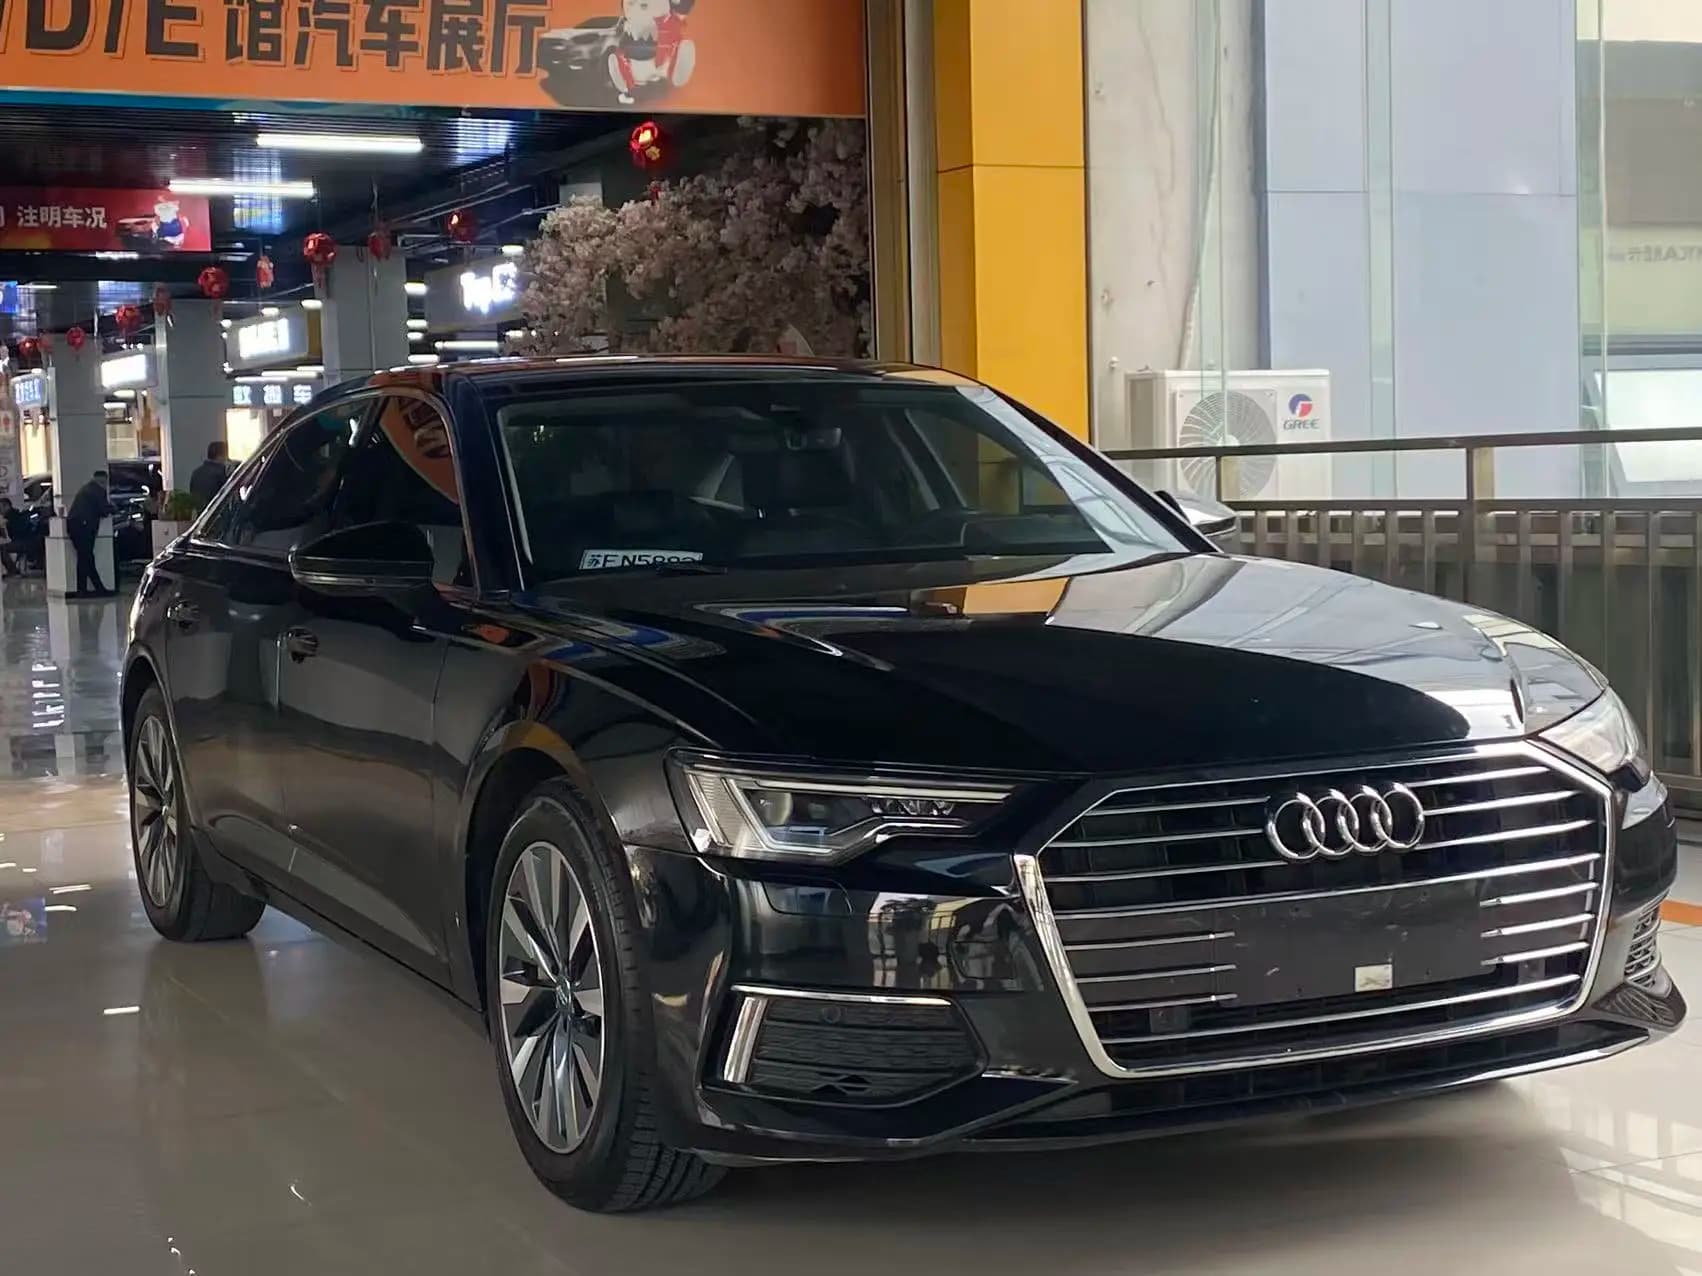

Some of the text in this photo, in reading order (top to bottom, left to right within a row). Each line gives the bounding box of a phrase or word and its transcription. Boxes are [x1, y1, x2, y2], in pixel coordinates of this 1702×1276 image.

[17, 205, 107, 228] 注明车况
[1283, 418, 1321, 430] GREE
